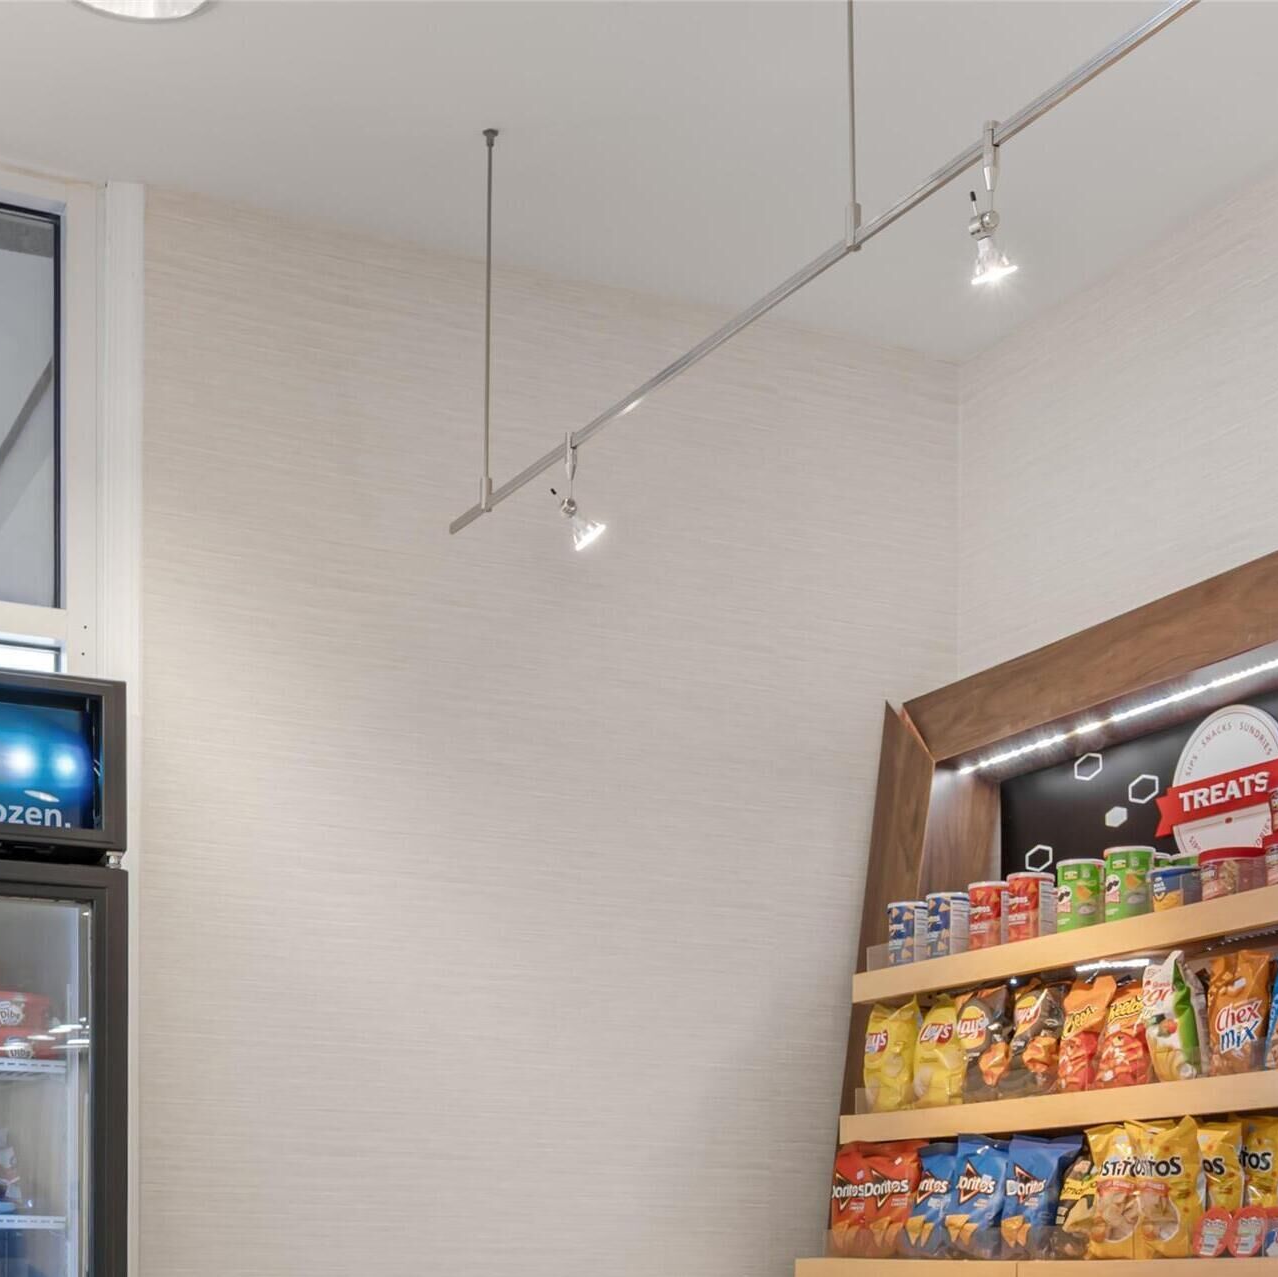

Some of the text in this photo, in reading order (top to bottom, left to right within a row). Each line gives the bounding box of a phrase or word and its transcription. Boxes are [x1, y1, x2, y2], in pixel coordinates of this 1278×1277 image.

[1201, 722, 1233, 747] SNACKS
[1239, 720, 1273, 757] SUNDRIES
[1178, 771, 1269, 812] TREATS
[1216, 1001, 1262, 1031] Chex
[865, 1179, 910, 1197] Doritos
